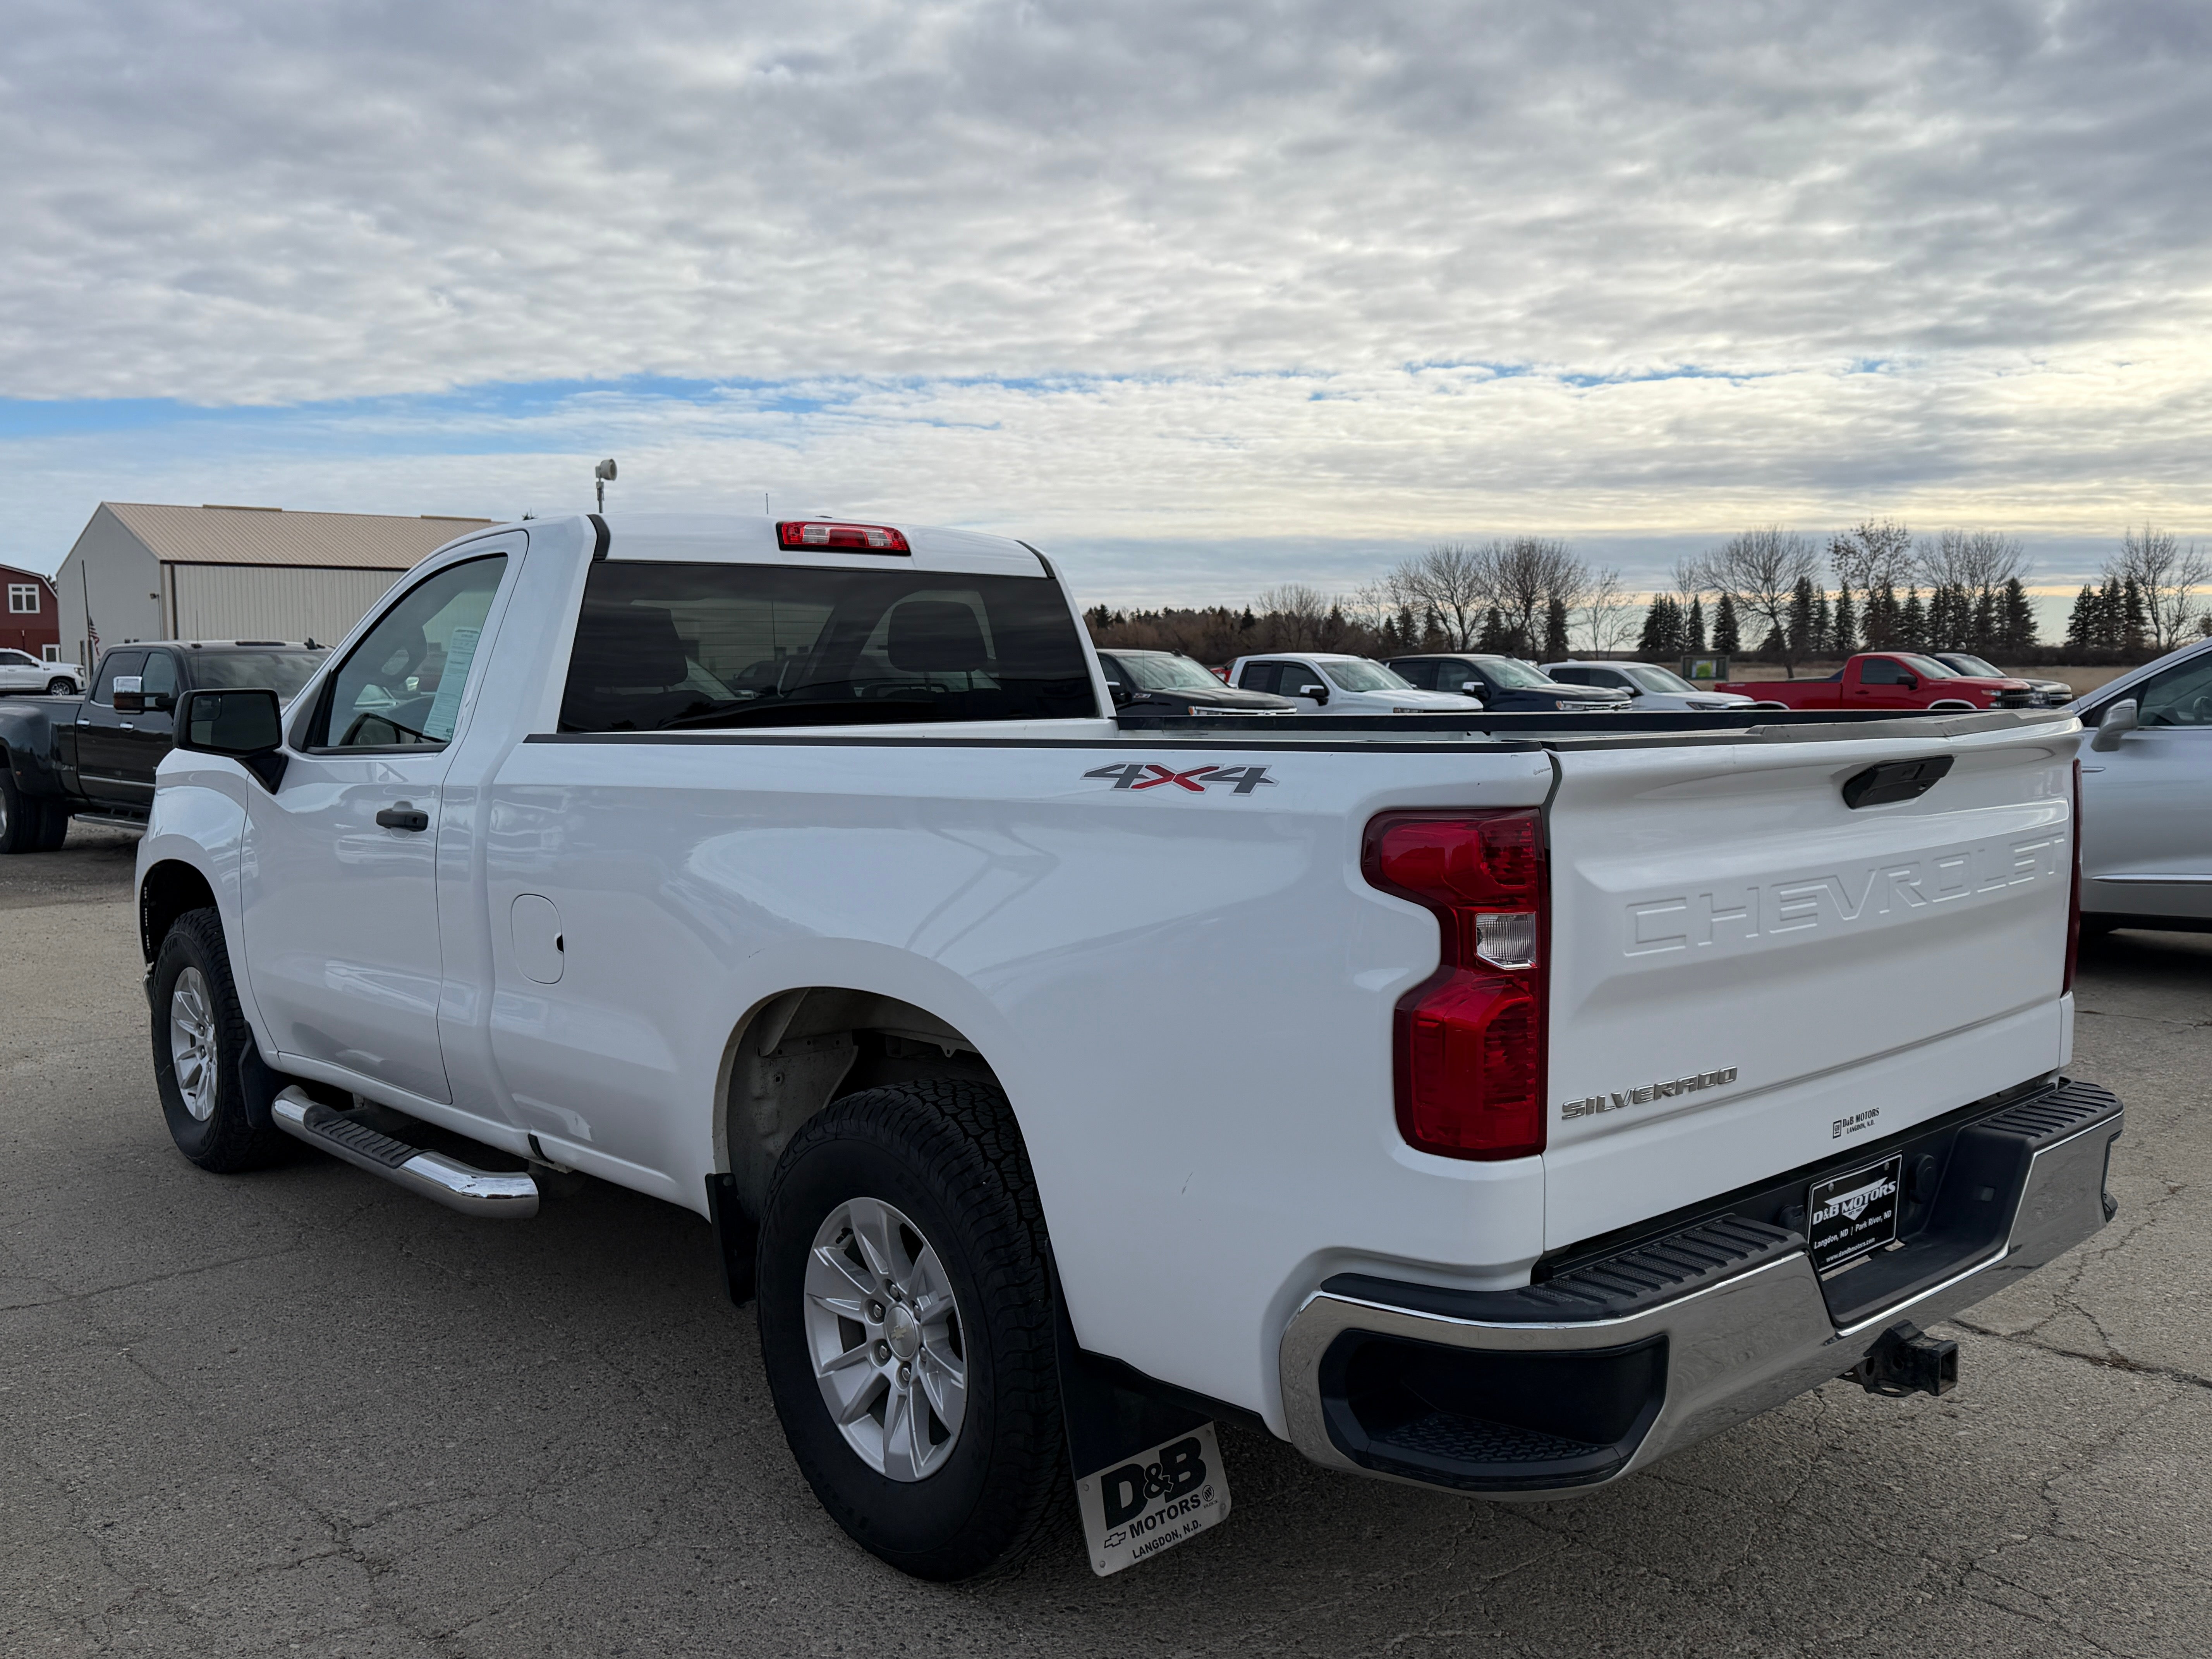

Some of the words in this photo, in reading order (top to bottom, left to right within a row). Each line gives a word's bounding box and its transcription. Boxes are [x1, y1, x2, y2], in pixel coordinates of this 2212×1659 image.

[1624, 831, 2065, 957] CHEVROLET
[1562, 1065, 1738, 1120] SILVERADO
[1856, 1108, 1879, 1123] MOTORS
[1813, 1204, 1839, 1225] D&B
[1842, 1181, 1896, 1213] MOTORS
[1814, 1234, 1839, 1249] Langdon,
[1840, 1228, 1848, 1238] ND
[1855, 1221, 1867, 1232] Park
[1868, 1216, 1883, 1226] River,
[1884, 1210, 1892, 1219] ND
[1101, 1437, 1207, 1531] D&B
[1129, 1494, 1200, 1539] MOTORS
[1132, 1529, 1182, 1559] LANGDON,
[1183, 1520, 1202, 1534] N.D.
